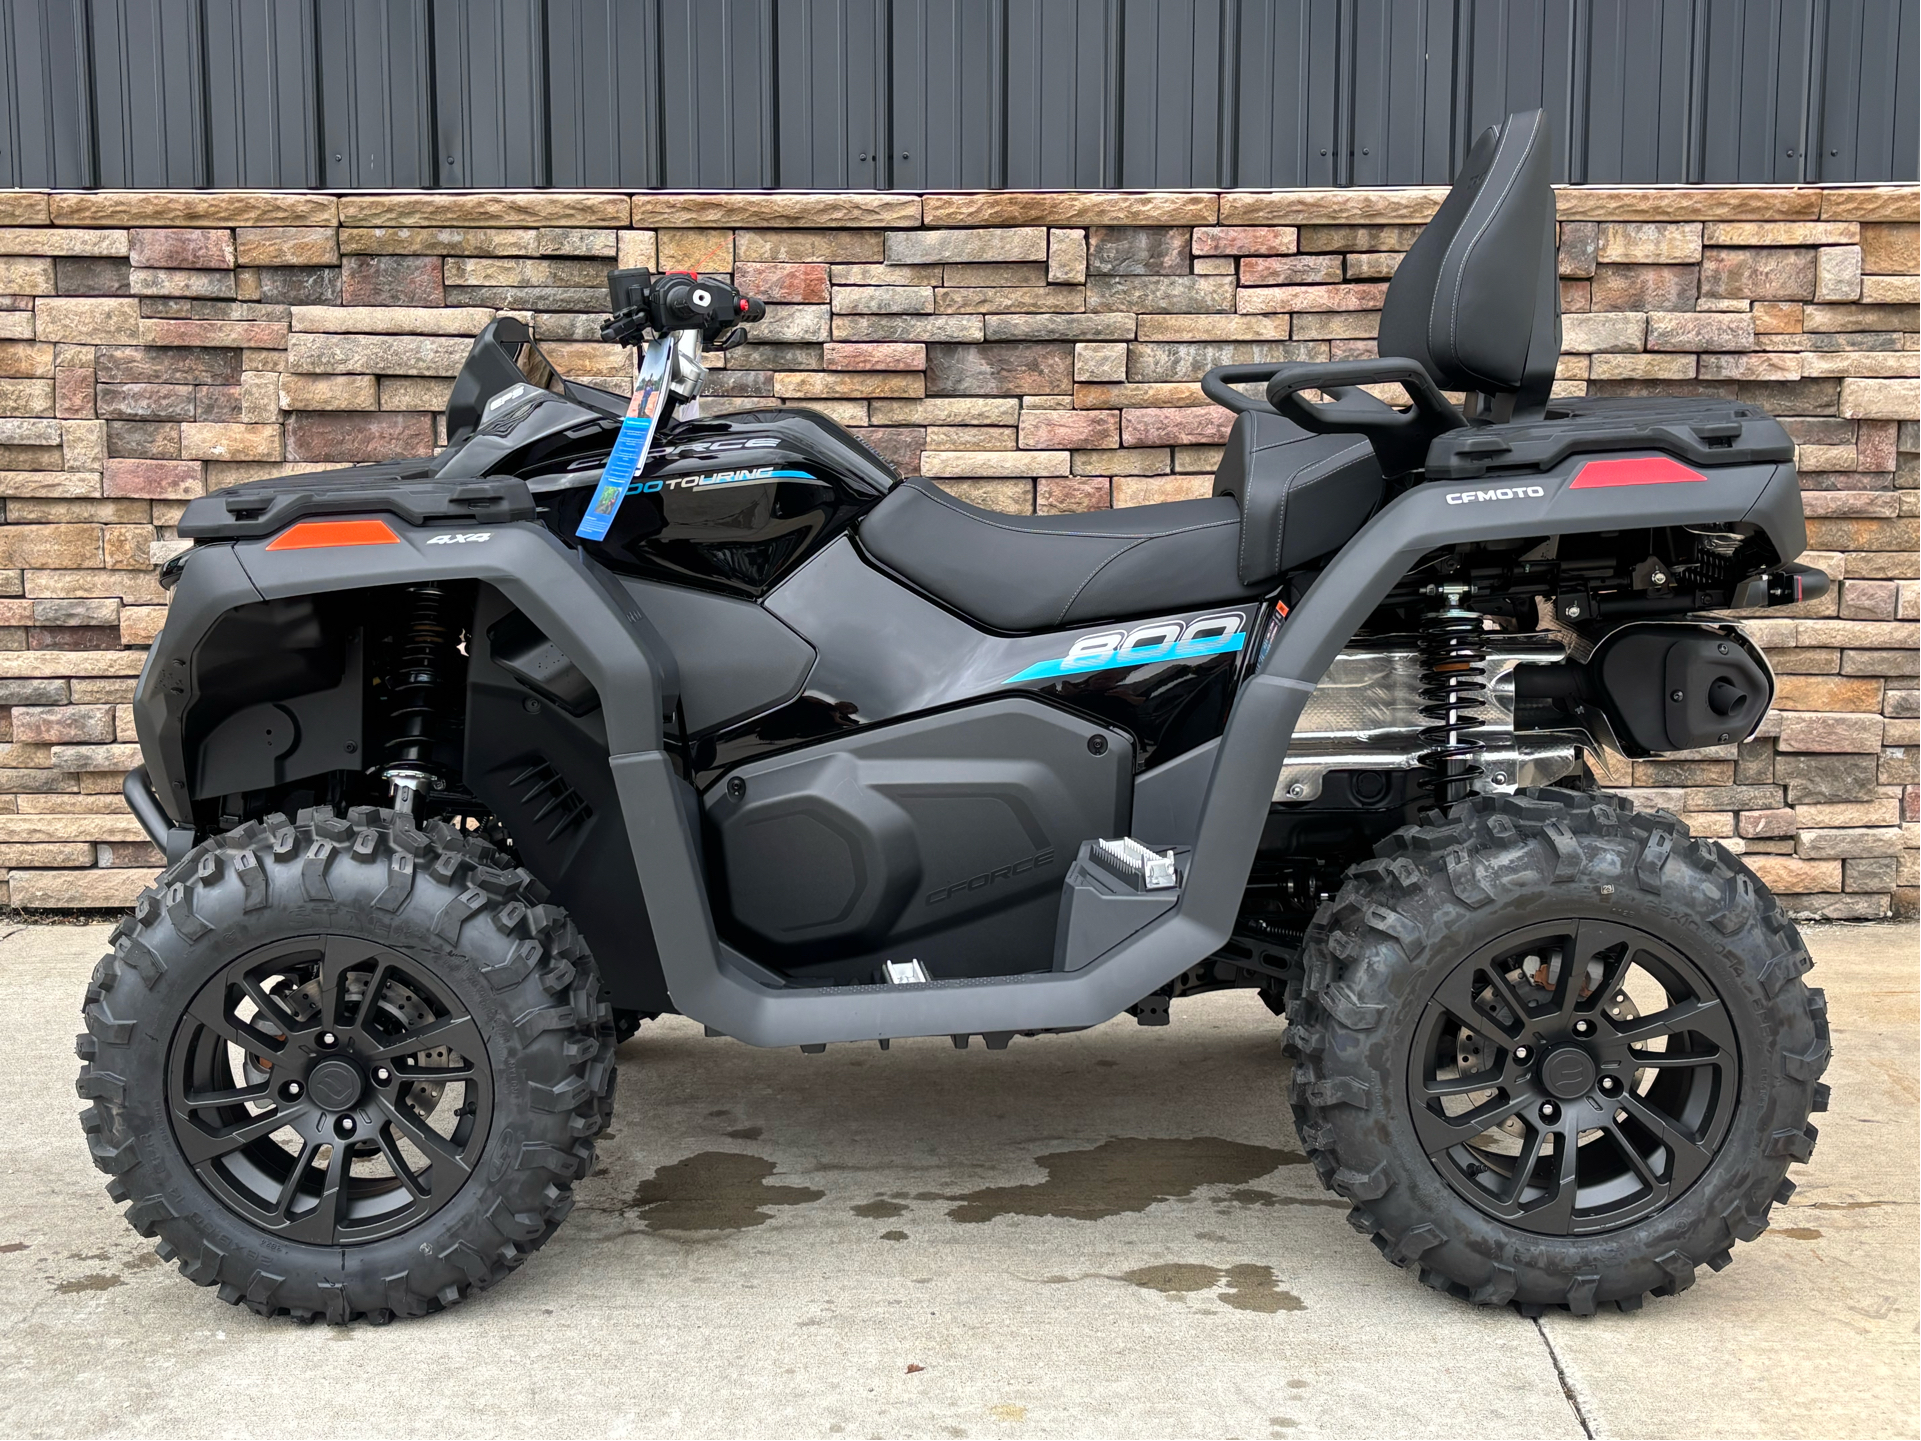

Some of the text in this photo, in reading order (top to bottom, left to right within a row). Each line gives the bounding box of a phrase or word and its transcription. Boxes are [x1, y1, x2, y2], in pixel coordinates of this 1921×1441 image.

[490, 385, 525, 411] EPS
[665, 466, 774, 491] TOURING
[1446, 486, 1545, 505] CFMOTO
[425, 532, 493, 545] 4X4
[1060, 611, 1247, 671] 800
[925, 847, 1056, 907] CFORCE
